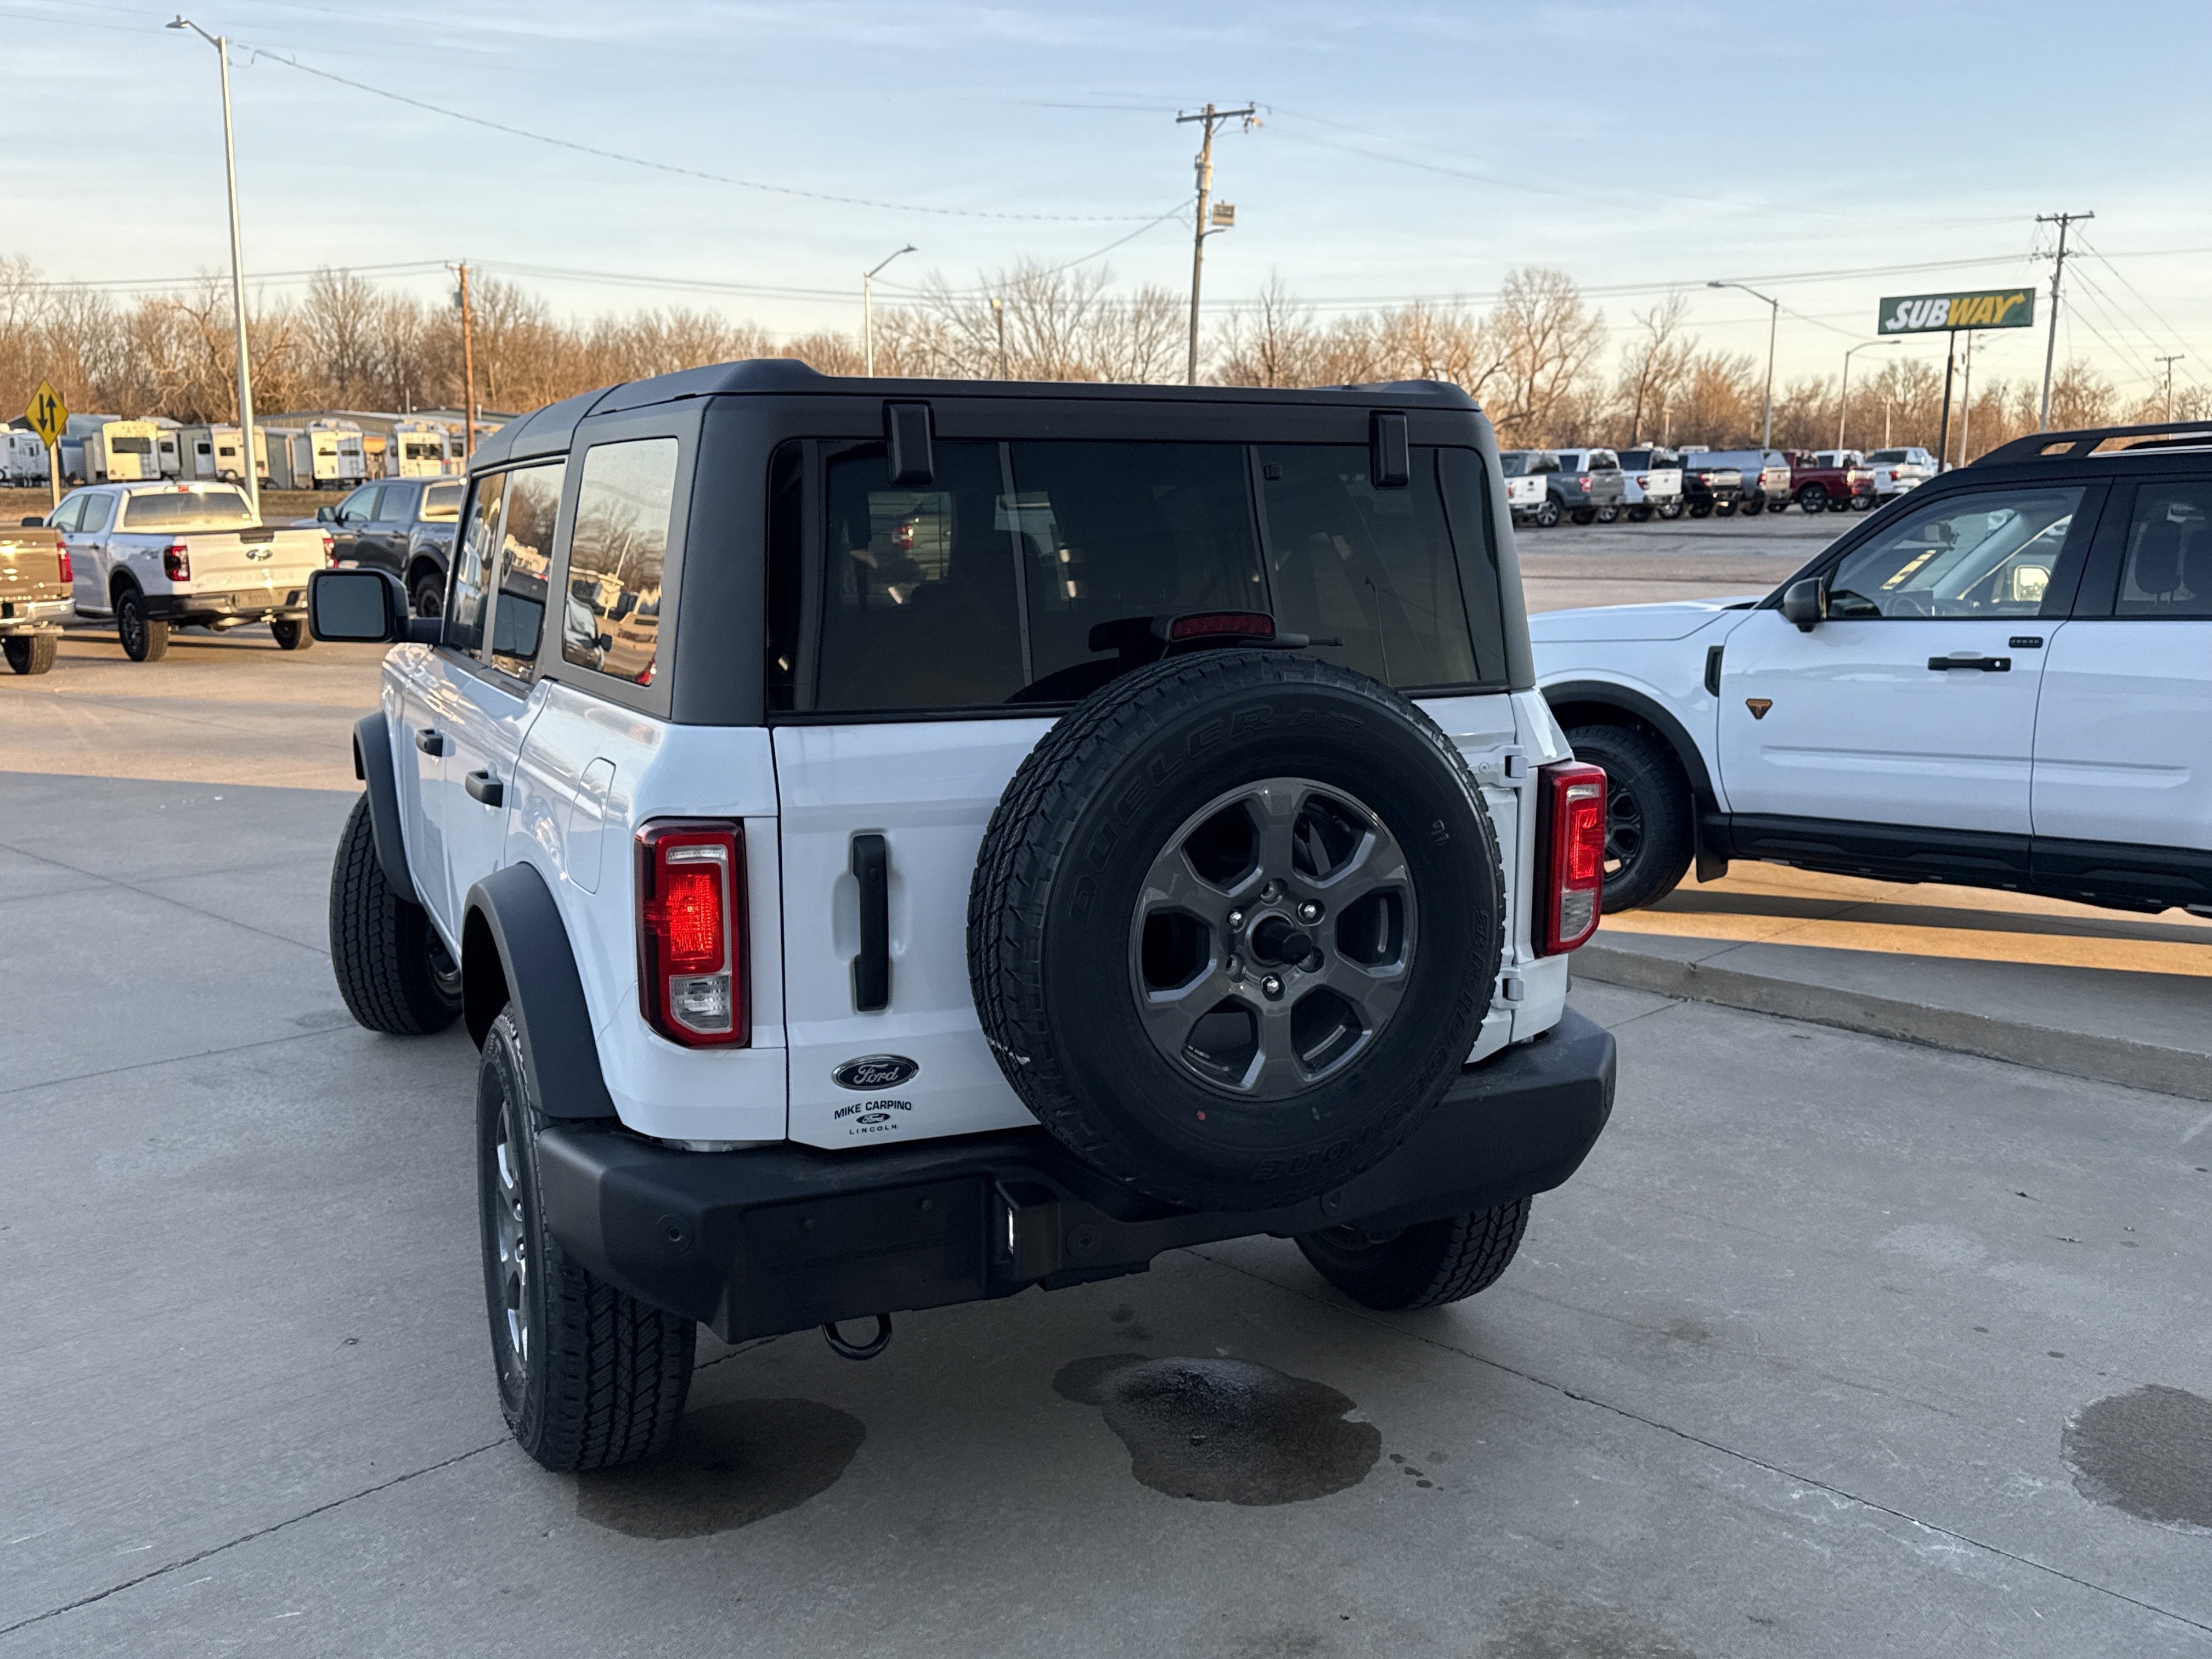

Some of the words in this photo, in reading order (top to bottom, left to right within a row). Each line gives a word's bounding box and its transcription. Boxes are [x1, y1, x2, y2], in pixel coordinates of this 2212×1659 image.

[1886, 292, 2025, 331] SUBWAY
[1067, 705, 1273, 932] DUELER
[853, 1063, 900, 1085] Ford
[834, 1103, 861, 1120] MIKE
[865, 1100, 912, 1111] CARPINO
[861, 1113, 885, 1124] Ford
[849, 1124, 897, 1135] LINCOLN
